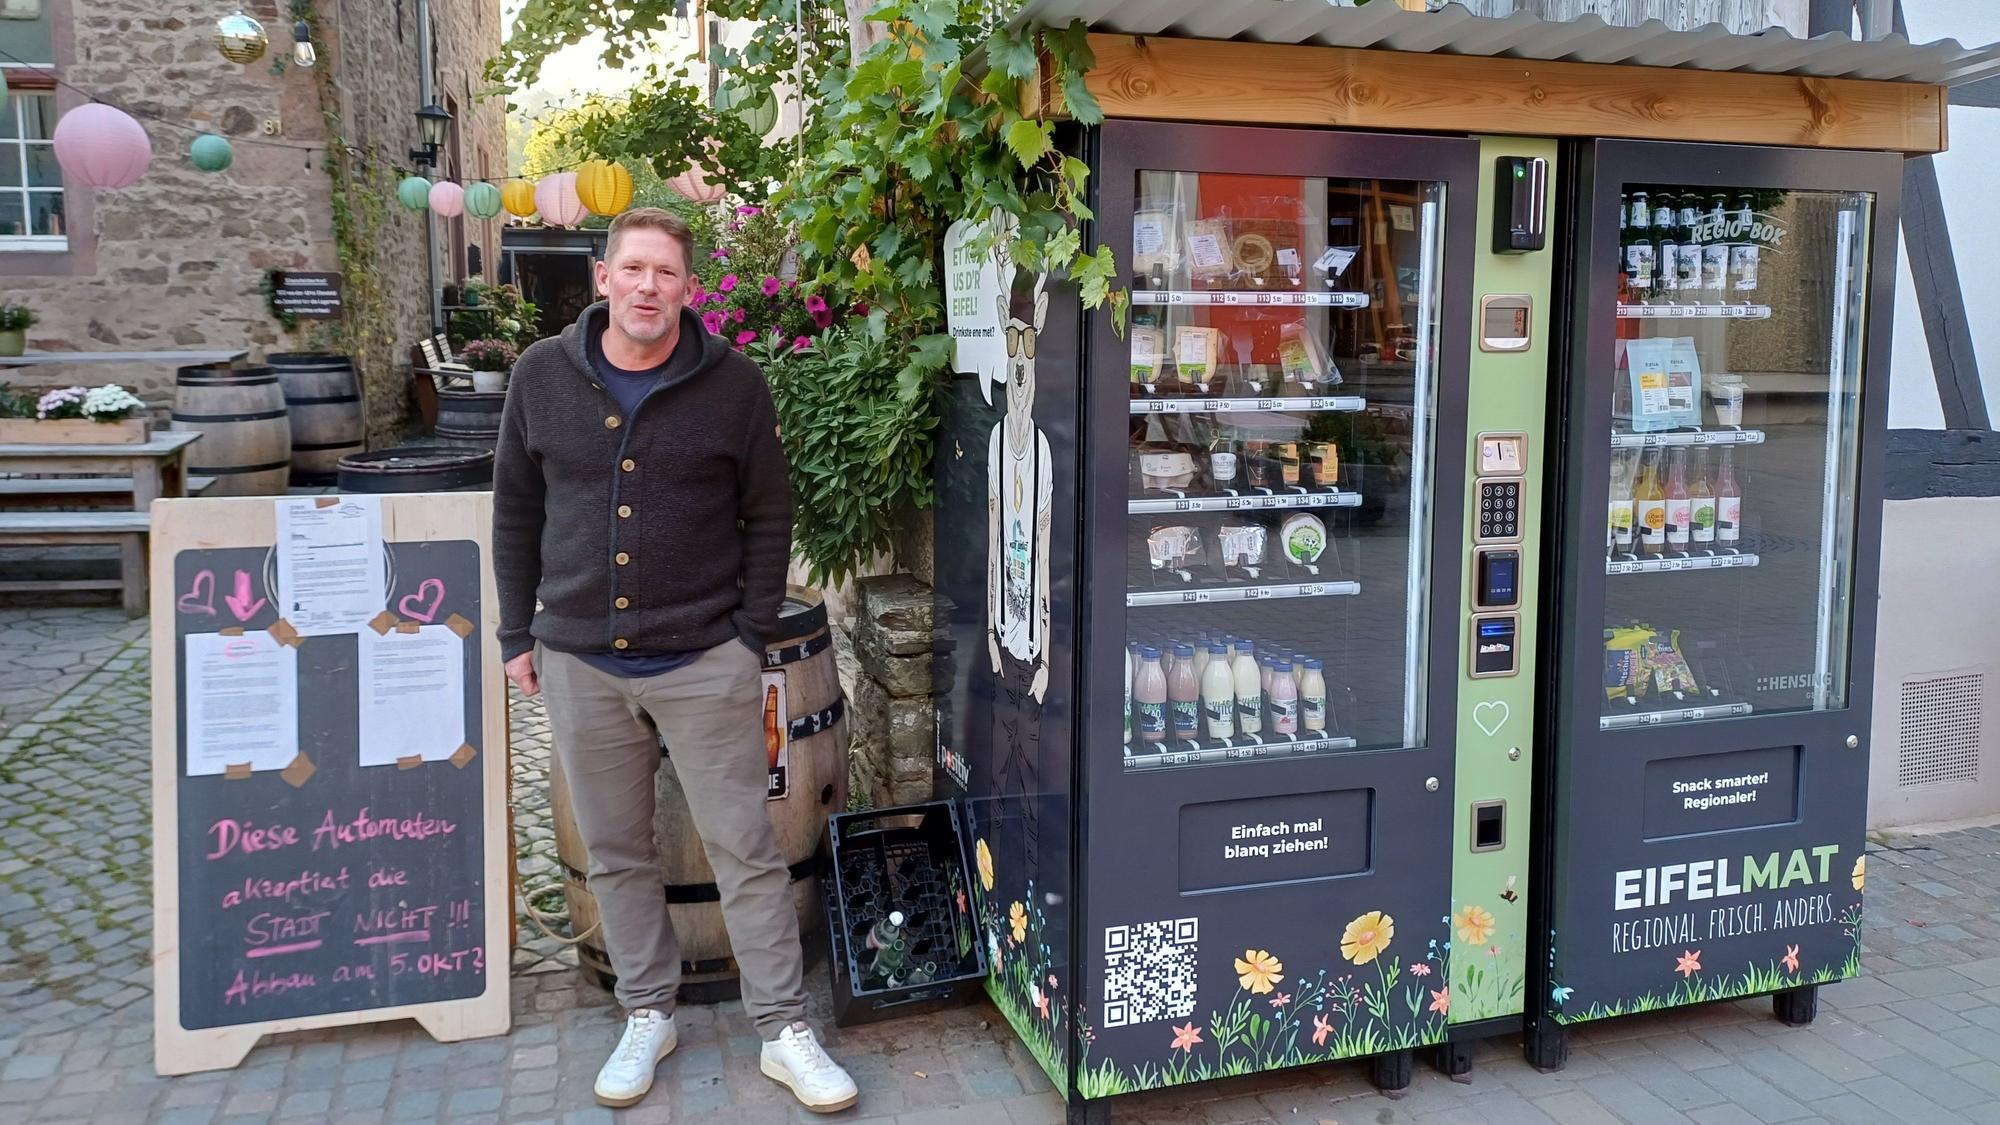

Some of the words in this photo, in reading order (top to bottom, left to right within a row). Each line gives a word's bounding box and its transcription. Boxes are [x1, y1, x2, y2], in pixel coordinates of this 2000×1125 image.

[263, 119, 281, 135] 81
[952, 247, 964, 267] ET
[953, 273, 964, 292] US
[952, 296, 978, 317] EIFEL!
[1156, 293, 1169, 302] 111
[1212, 294, 1225, 303] 112
[1151, 401, 1163, 410] 121
[1176, 501, 1189, 510] 131
[1228, 499, 1240, 508] 132
[1297, 497, 1309, 505] 134
[1326, 496, 1338, 504] 135
[1162, 756, 1174, 764] 152
[1227, 750, 1239, 758] 154
[1672, 777, 1712, 794] Snack
[1715, 772, 1769, 790] smarter!
[1683, 790, 1757, 811] Regionaler!
[207, 818, 300, 861] Diese
[312, 806, 457, 852] Automaten
[1231, 822, 1290, 840] Einfach
[1294, 818, 1323, 833] mal
[1224, 844, 1269, 859] blanq
[1272, 837, 1329, 854] ziehen!
[368, 868, 408, 888] die
[1614, 844, 1839, 911] EIFELMAT
[244, 911, 332, 946] STADT
[353, 904, 438, 934] NICHT
[1613, 913, 1703, 953] REGIONAL.
[1709, 902, 1767, 940] FRISCH.
[1774, 893, 1837, 930] ANDERS.
[224, 968, 317, 1006] Abbau
[333, 965, 376, 984] am
